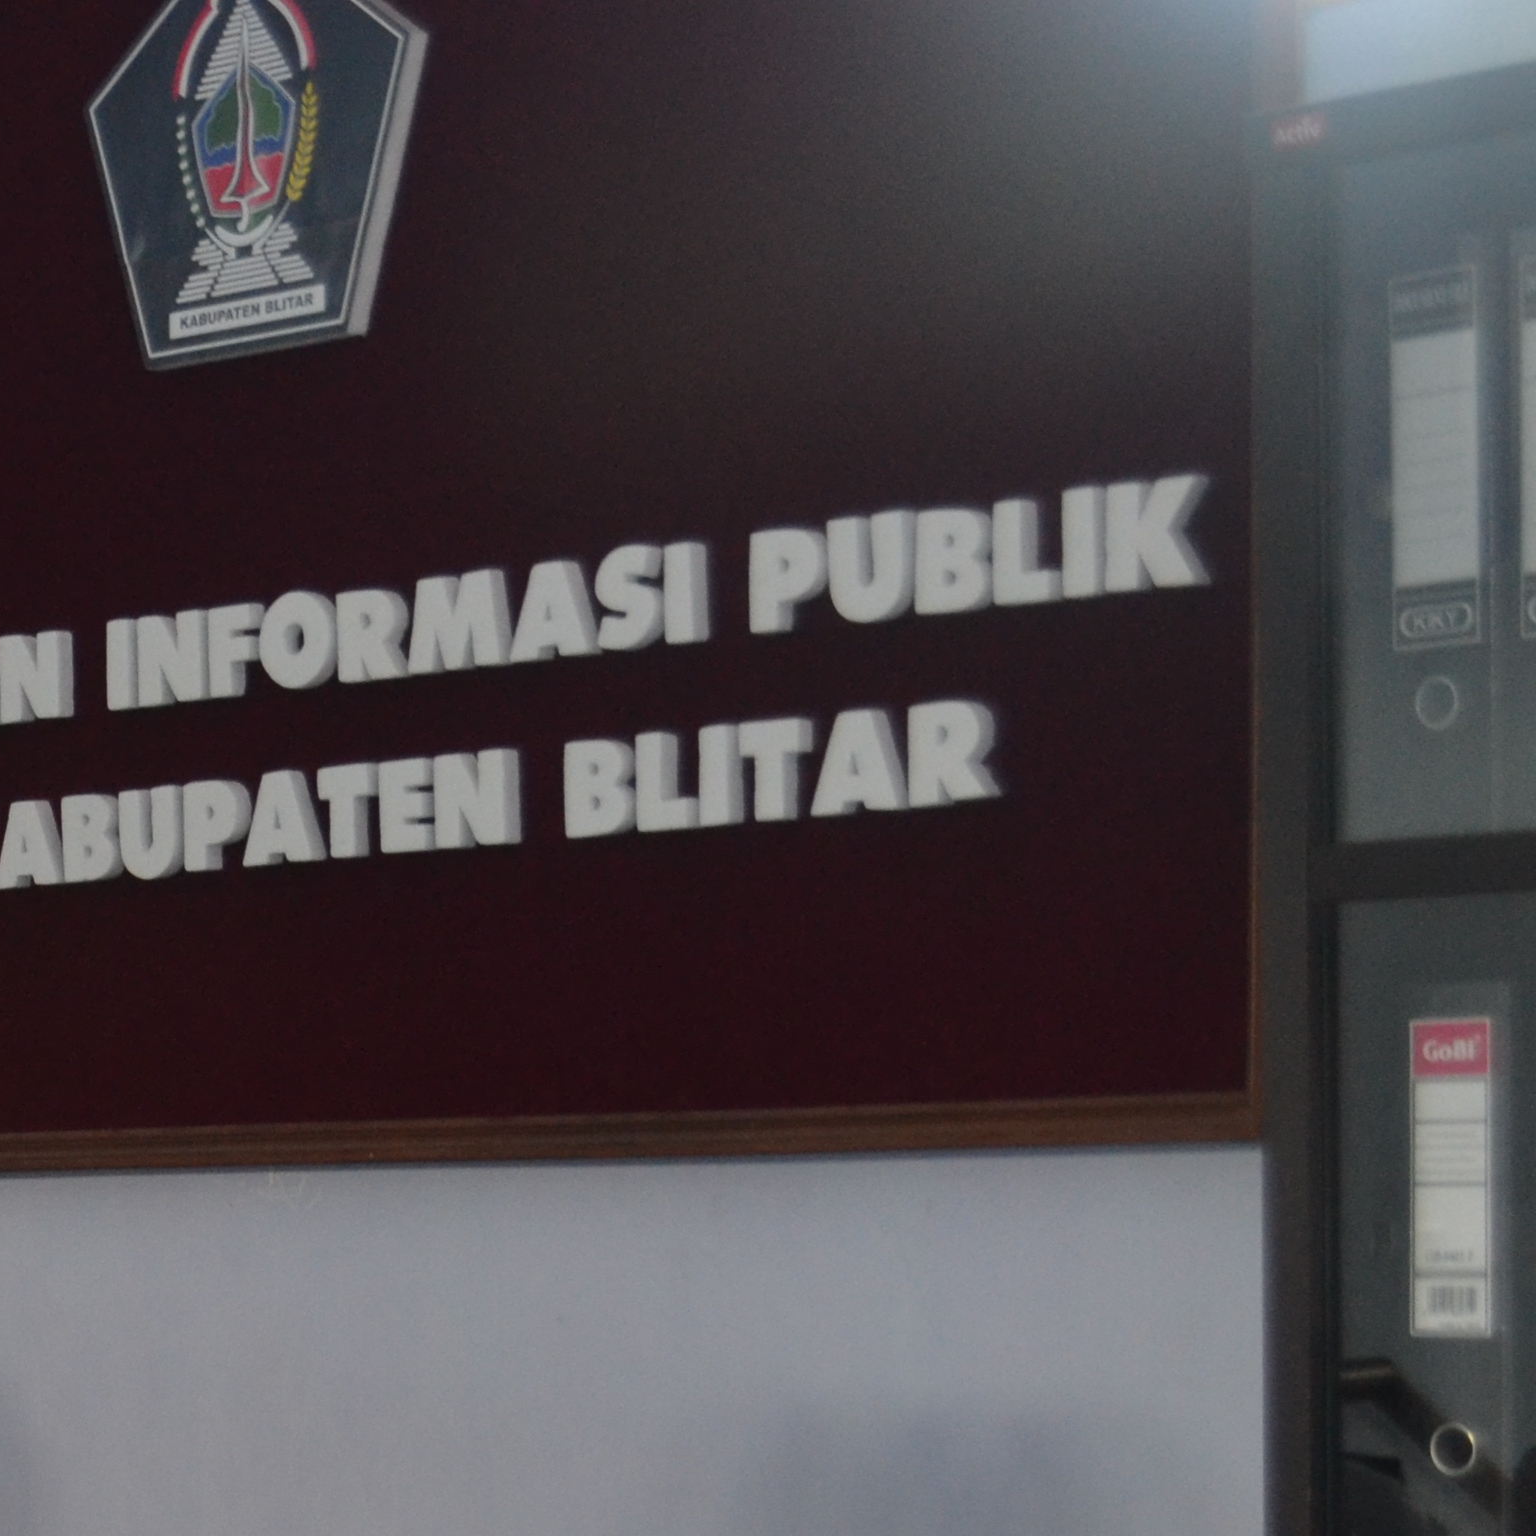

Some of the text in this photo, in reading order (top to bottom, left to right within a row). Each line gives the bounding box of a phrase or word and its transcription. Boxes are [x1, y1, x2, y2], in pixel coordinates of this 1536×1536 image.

[179, 292, 314, 330] KABUPATEN BLITAR
[106, 540, 710, 711] INFORMASI
[749, 473, 1212, 634] PUBLIK
[563, 700, 1004, 839] BLITAR
